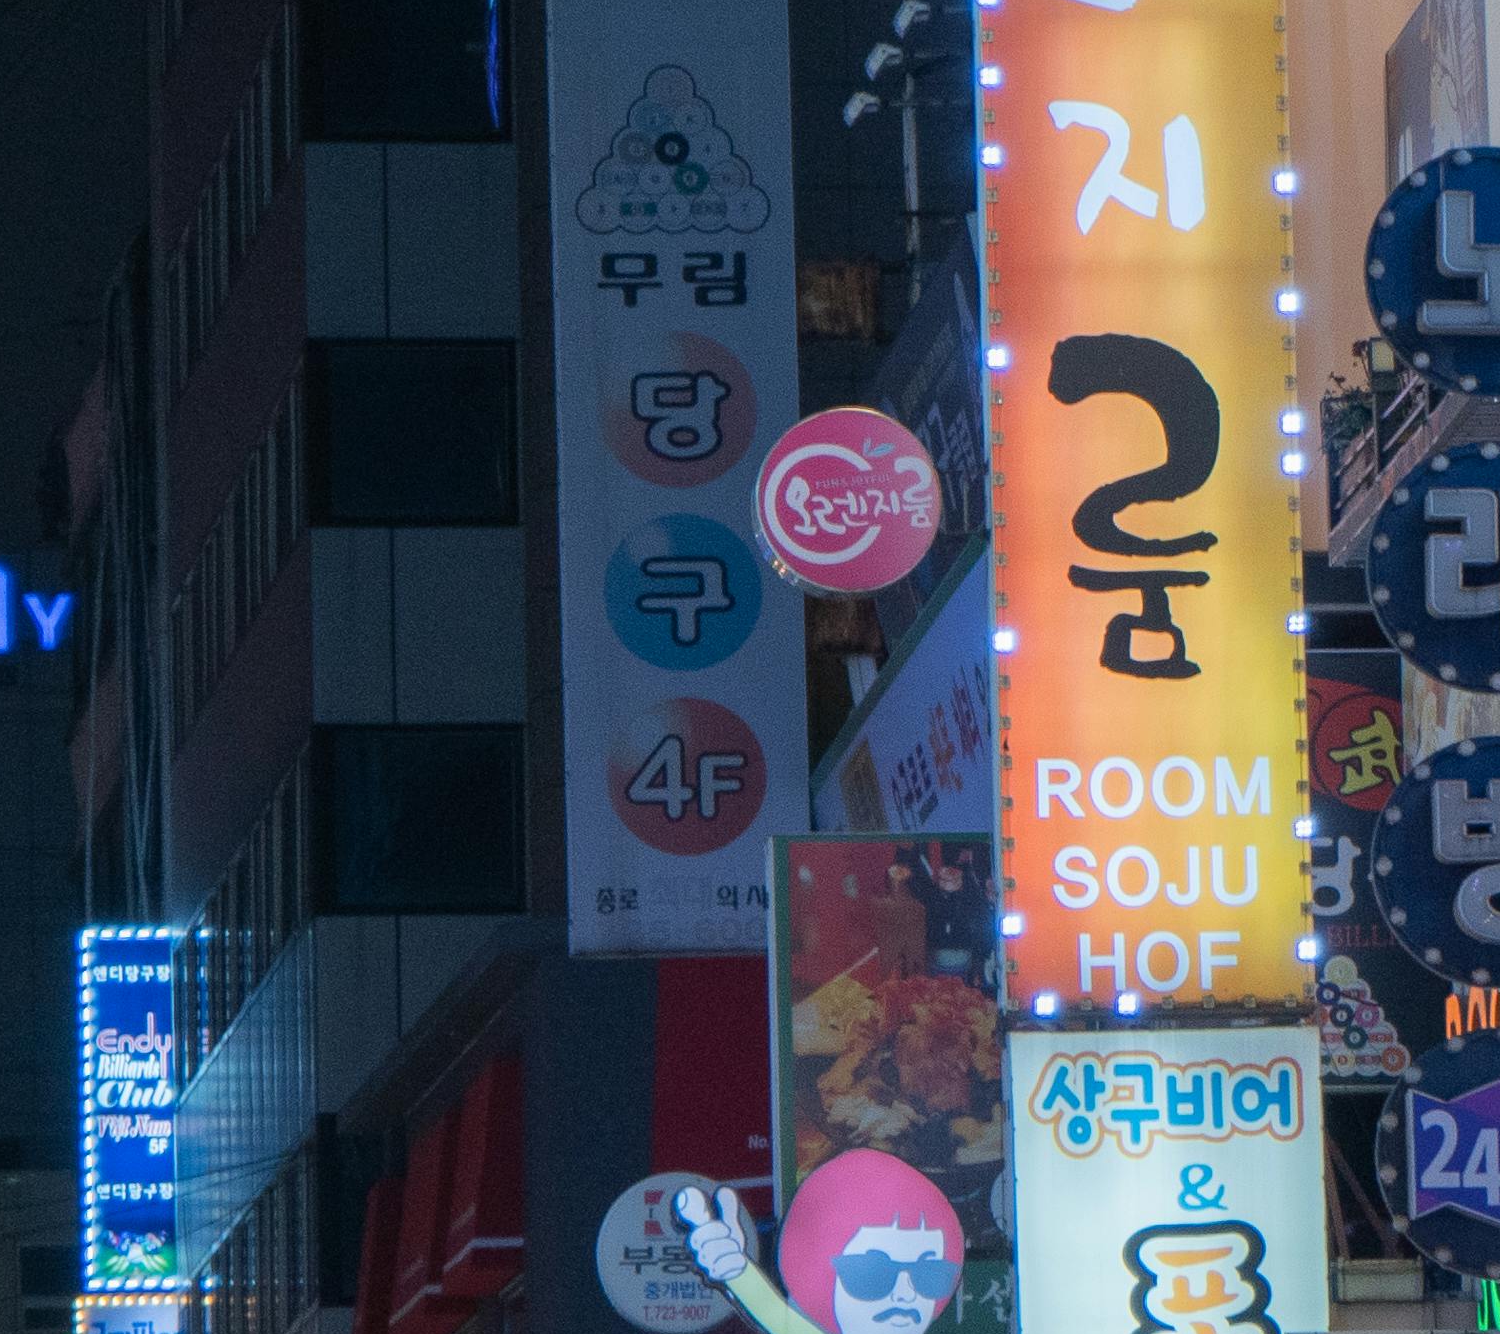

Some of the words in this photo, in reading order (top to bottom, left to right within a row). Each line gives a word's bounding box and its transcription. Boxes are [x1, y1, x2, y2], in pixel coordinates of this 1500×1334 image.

[597, 249, 748, 310] 무림
[785, 456, 933, 536] 오렌지룸
[625, 731, 748, 825] 4F
[1034, 756, 1273, 820] ROOM
[1052, 844, 1260, 911] SOJU
[1077, 931, 1242, 994] HOF
[96, 1011, 172, 1078] Endy
[97, 1053, 162, 1080] Billiards
[97, 1079, 173, 1109] Club
[1038, 1057, 1297, 1153] 상구비어
[1176, 1162, 1227, 1211] &
[618, 1245, 697, 1277] 부동
